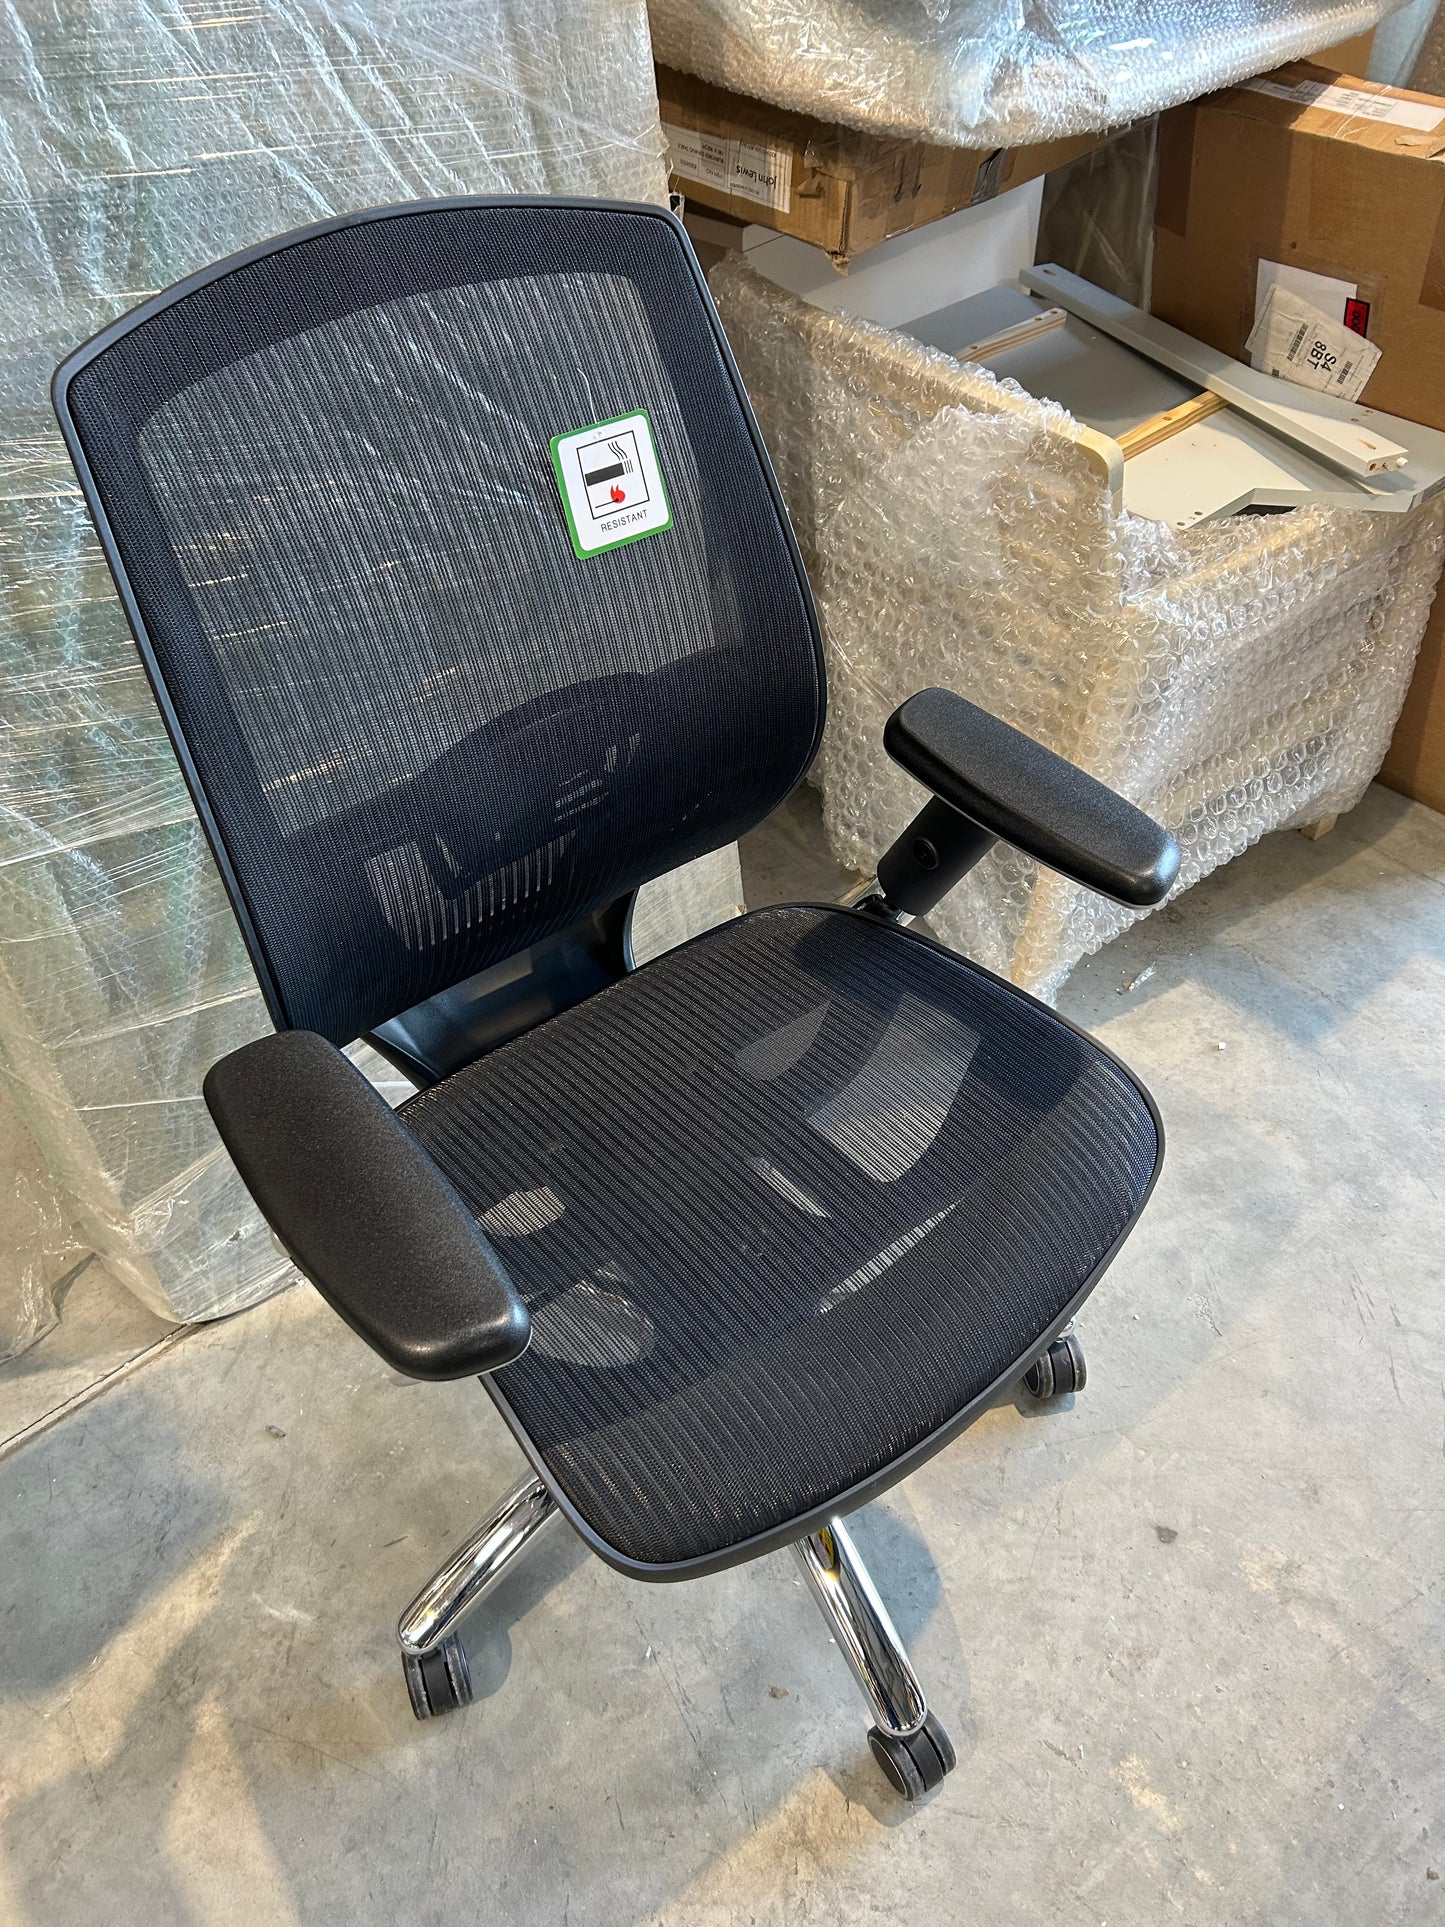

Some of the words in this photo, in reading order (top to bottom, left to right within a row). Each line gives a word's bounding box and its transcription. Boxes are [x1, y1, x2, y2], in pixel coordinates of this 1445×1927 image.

[736, 165, 757, 182] Lewis
[758, 173, 777, 190] John
[1307, 340, 1327, 370] 8BT
[1320, 352, 1337, 372] S4
[600, 509, 648, 533] RESISTANT
